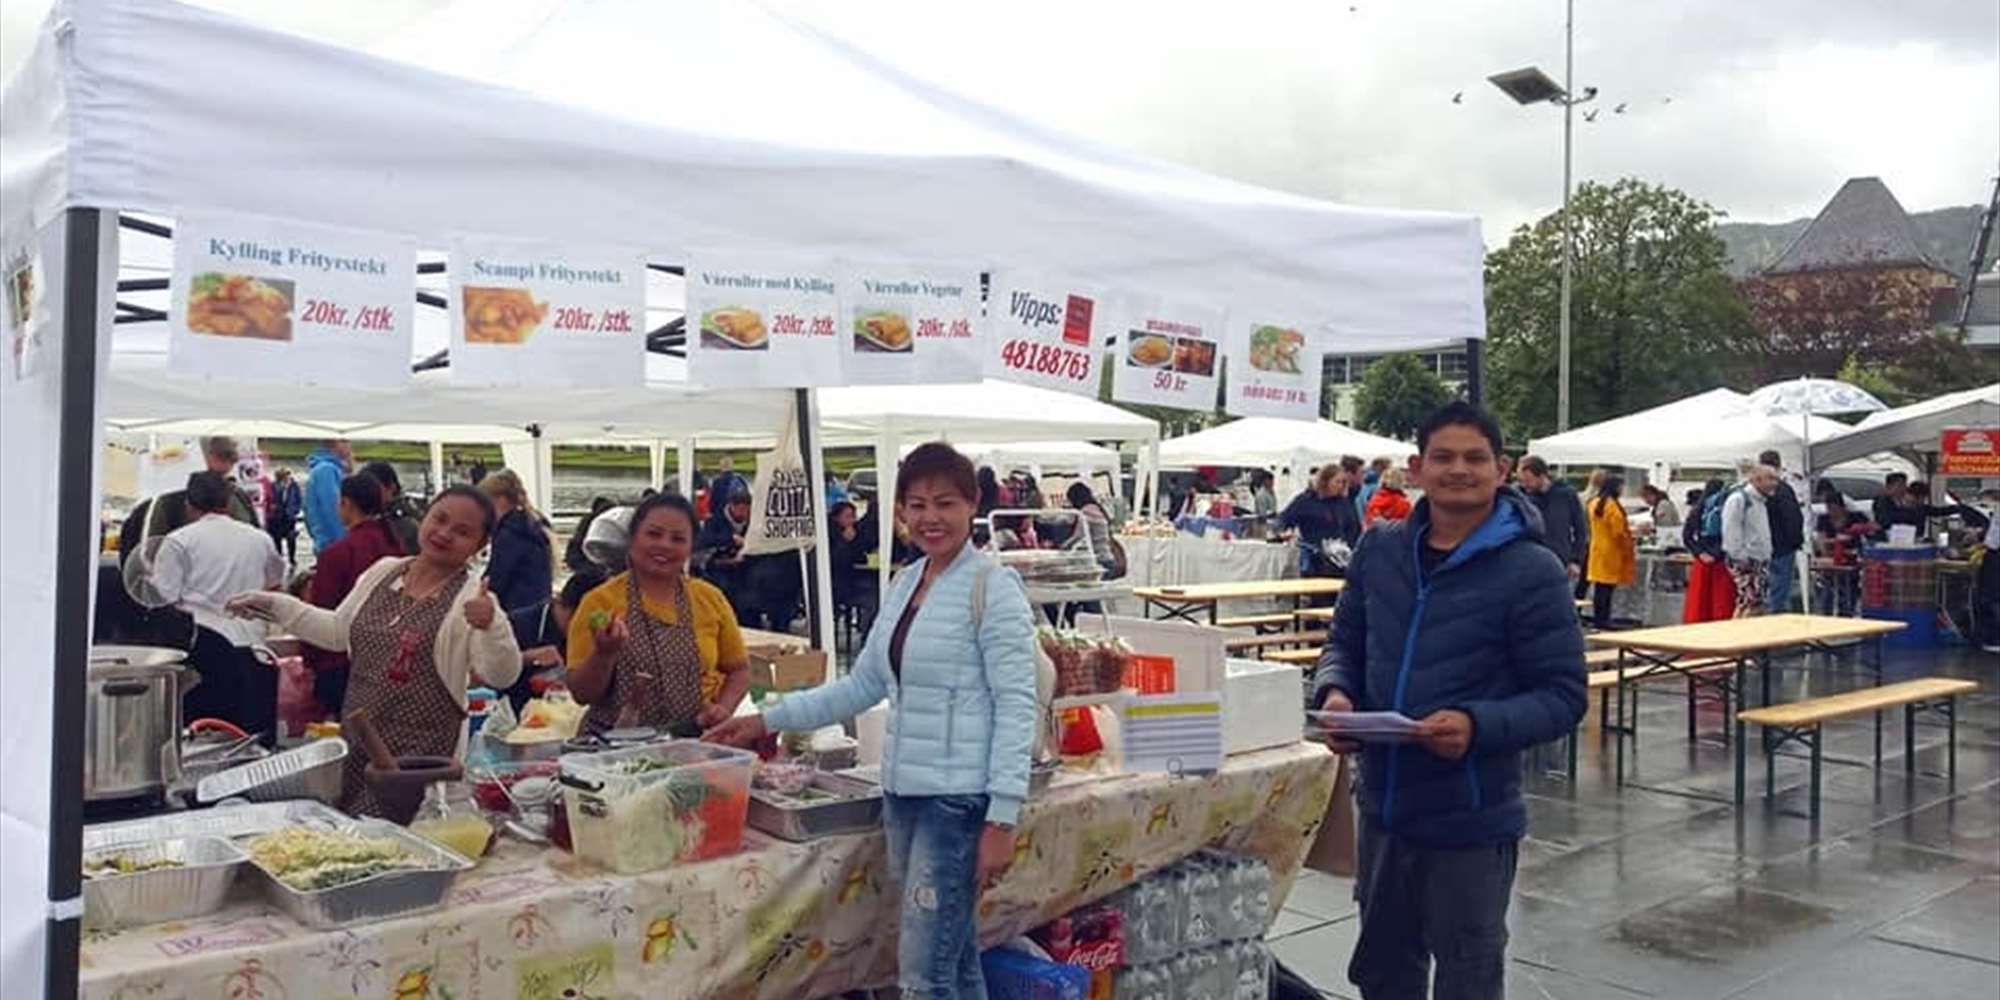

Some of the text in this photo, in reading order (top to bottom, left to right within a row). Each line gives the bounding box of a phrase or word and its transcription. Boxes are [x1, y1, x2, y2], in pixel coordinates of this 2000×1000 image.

[288, 248, 387, 275] Frityrstekt
[474, 261, 621, 283] Scampi Frityrstekt
[766, 277, 791, 290] med
[302, 300, 395, 331] 20kr. /stk.
[554, 307, 633, 333] 20kr. /stk.
[1010, 290, 1063, 328] Vipps:
[772, 314, 806, 334] 20kr.
[1001, 339, 1091, 381] 48188763
[1153, 371, 1172, 391] 50
